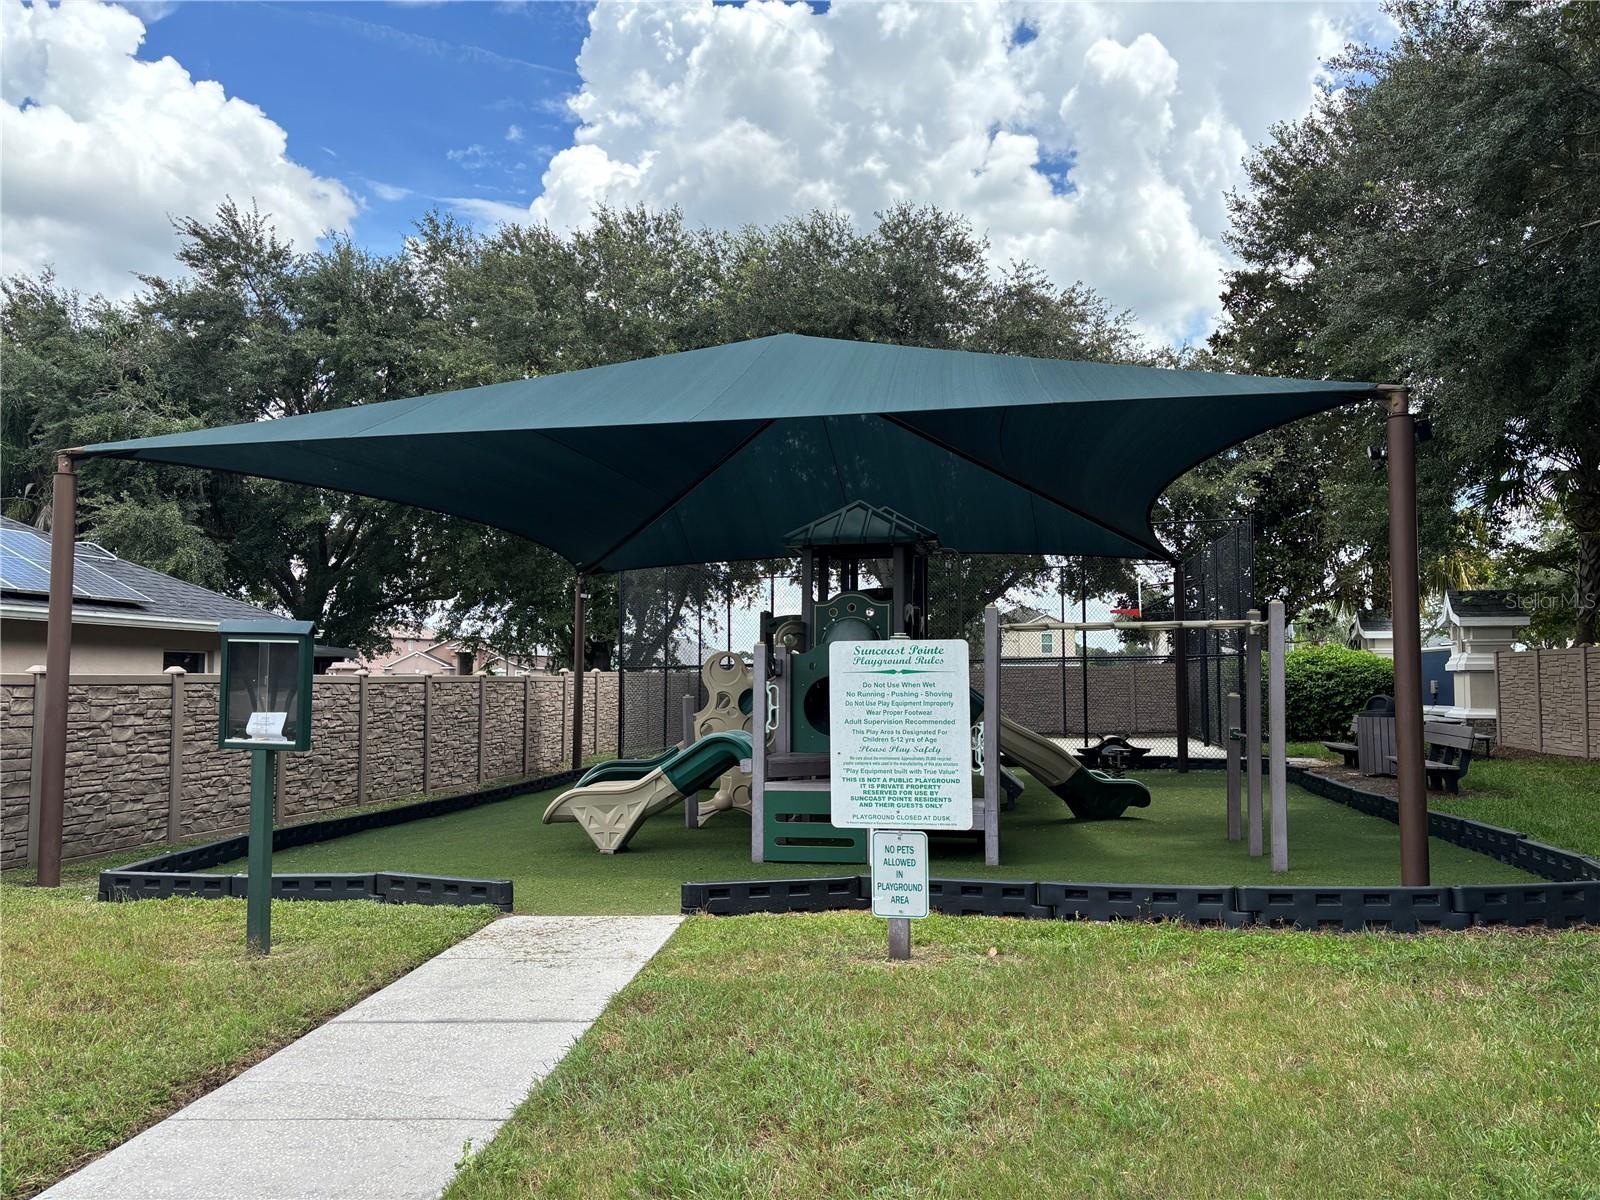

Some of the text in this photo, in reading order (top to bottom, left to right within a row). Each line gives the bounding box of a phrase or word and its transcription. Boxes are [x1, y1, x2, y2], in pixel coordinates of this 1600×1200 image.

[854, 645, 944, 655] Suncoast Pointe
[853, 656, 944, 667] Playground Rules
[878, 883, 922, 892] PLAYGROUND
